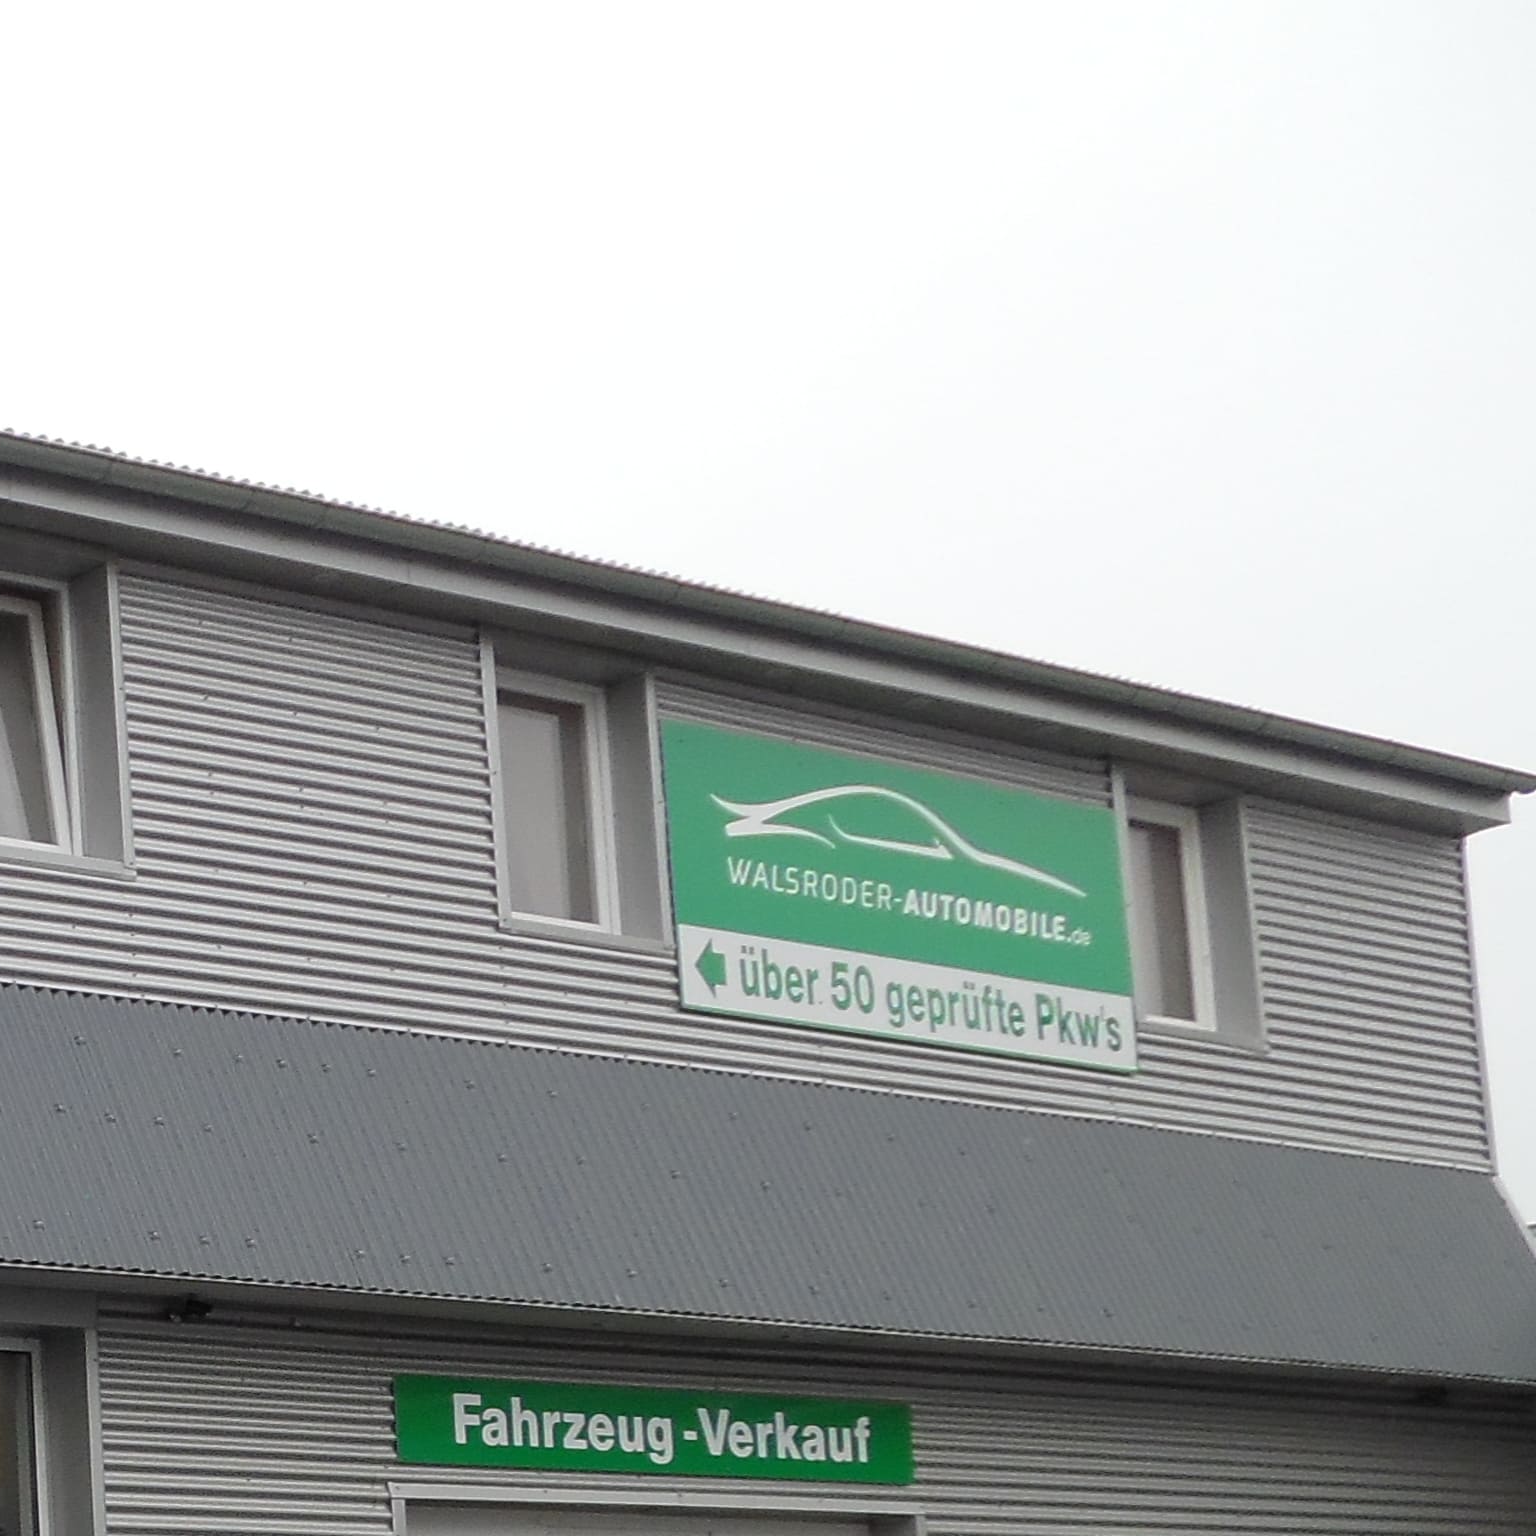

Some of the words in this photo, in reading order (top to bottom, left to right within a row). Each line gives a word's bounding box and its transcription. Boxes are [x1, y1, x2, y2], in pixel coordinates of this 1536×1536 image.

[727, 855, 1091, 946] WALSRODER-AUTOMOBILE.de
[739, 944, 820, 1006] über
[830, 960, 875, 1013] 50
[885, 981, 1026, 1037] geprüfte
[1035, 993, 1123, 1053] Pkw's
